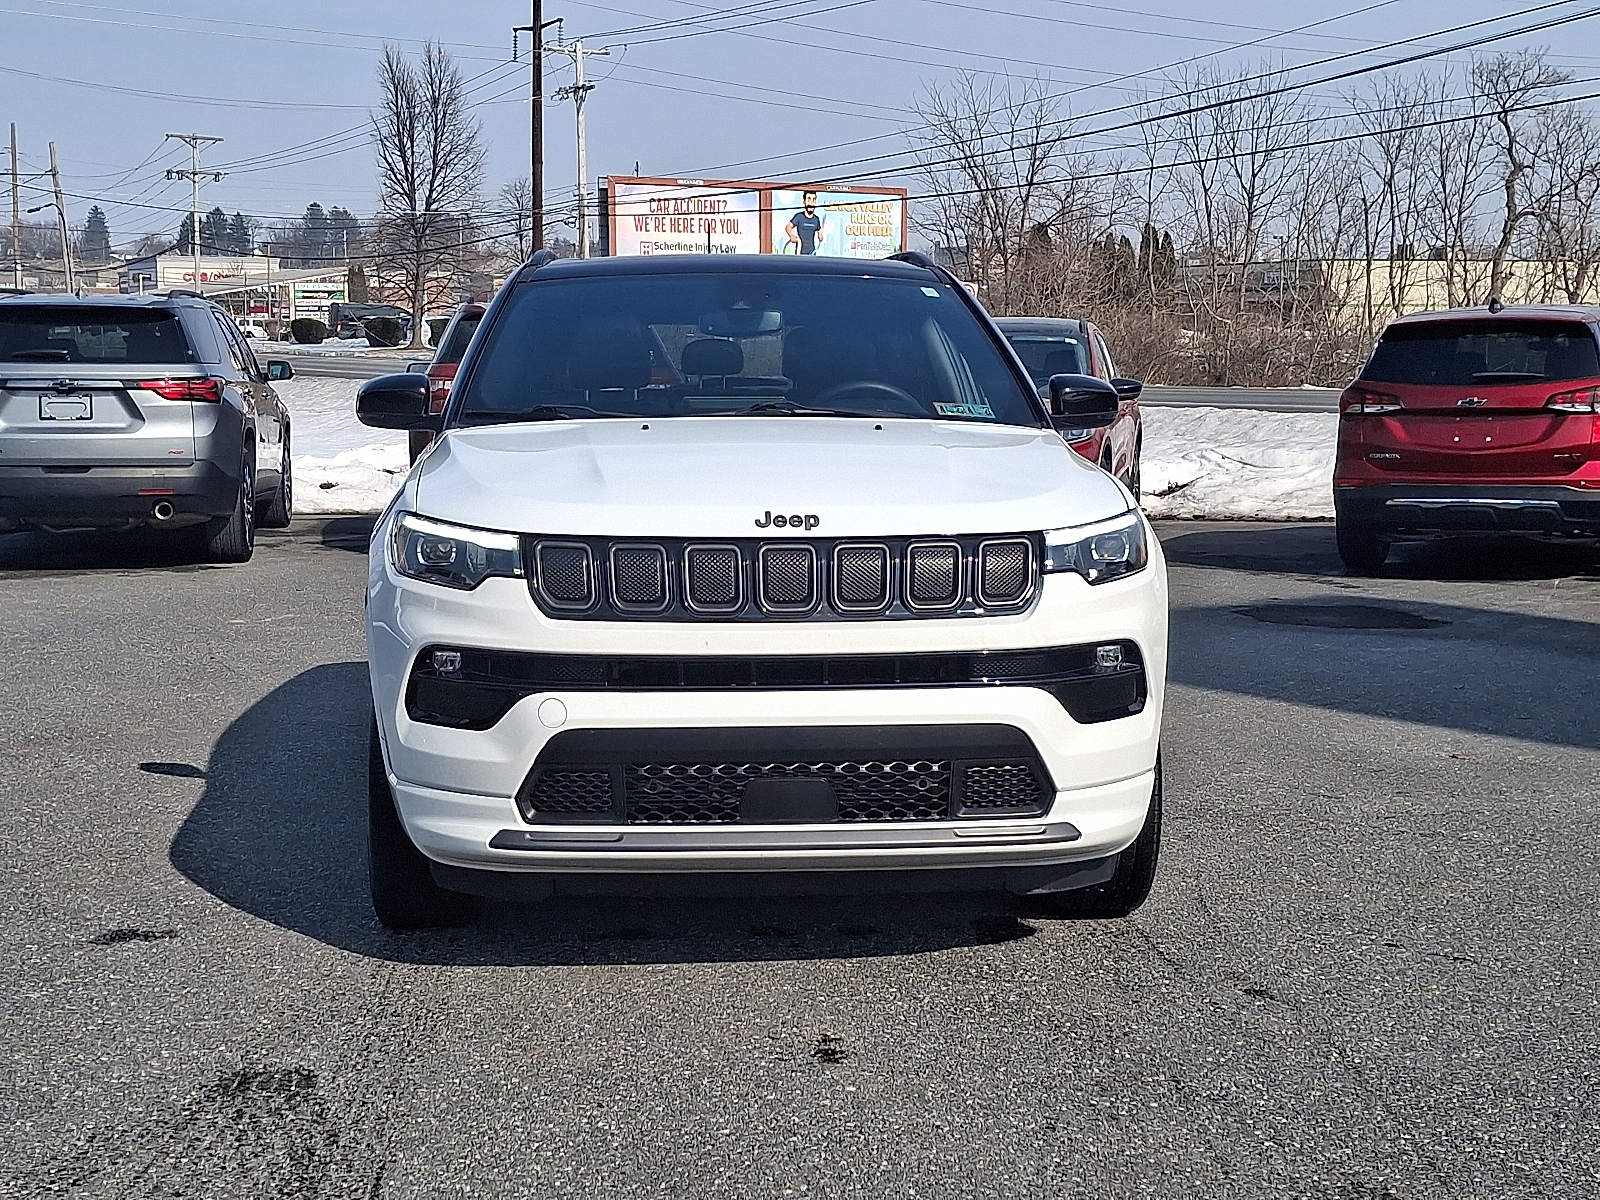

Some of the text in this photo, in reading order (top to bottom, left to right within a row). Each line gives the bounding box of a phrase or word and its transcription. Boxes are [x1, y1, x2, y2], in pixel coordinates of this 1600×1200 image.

[649, 198, 728, 215] CAR ACCIDENT?
[634, 216, 742, 235] WE'RE HERE FOR YOU.
[755, 511, 819, 530] Jeep
